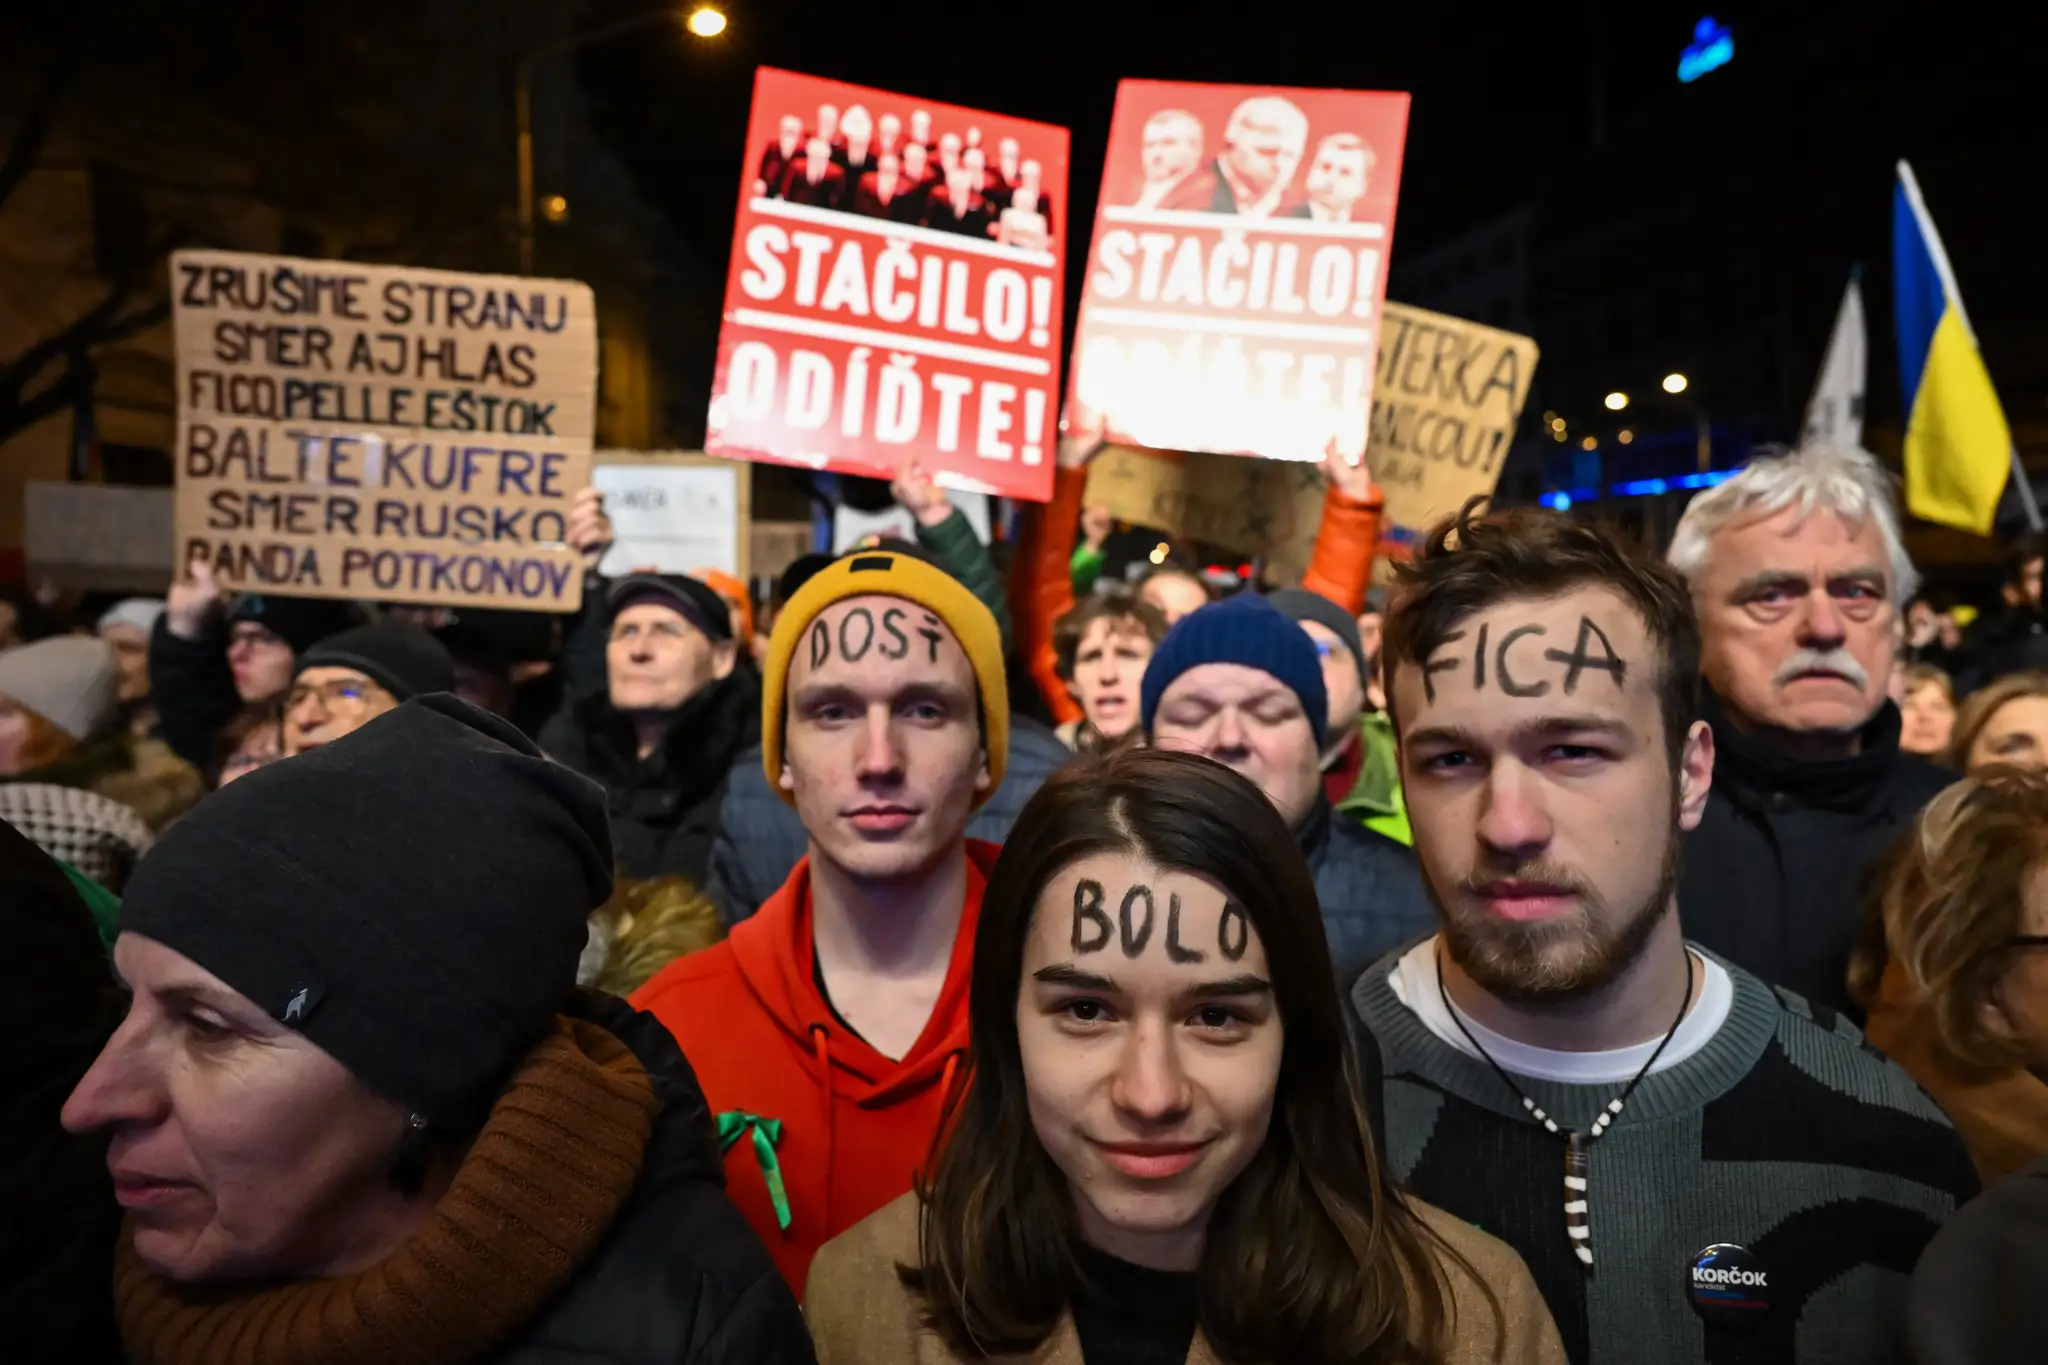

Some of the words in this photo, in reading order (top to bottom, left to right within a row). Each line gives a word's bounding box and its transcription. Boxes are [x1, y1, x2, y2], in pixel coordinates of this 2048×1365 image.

[180, 264, 370, 321] ZRUŠIME
[383, 280, 567, 334] STRANU
[740, 225, 1053, 348] STAČILO!
[1091, 229, 1380, 318] STAČILO!
[214, 321, 334, 371] SMER
[347, 330, 408, 375] AJ
[415, 334, 537, 388] HLAS
[425, 388, 556, 436] EŠTOK
[726, 341, 1047, 466] ODÍĎTE!
[186, 424, 362, 488] BALTE
[383, 442, 568, 498] KUFRE
[208, 490, 360, 536] SMER
[373, 500, 566, 546] RUSKO
[342, 547, 572, 599] POTKONOV
[1421, 615, 1627, 707] FICA
[1071, 877, 1248, 963] BOLO
[1692, 1265, 1768, 1287] KORČOK
